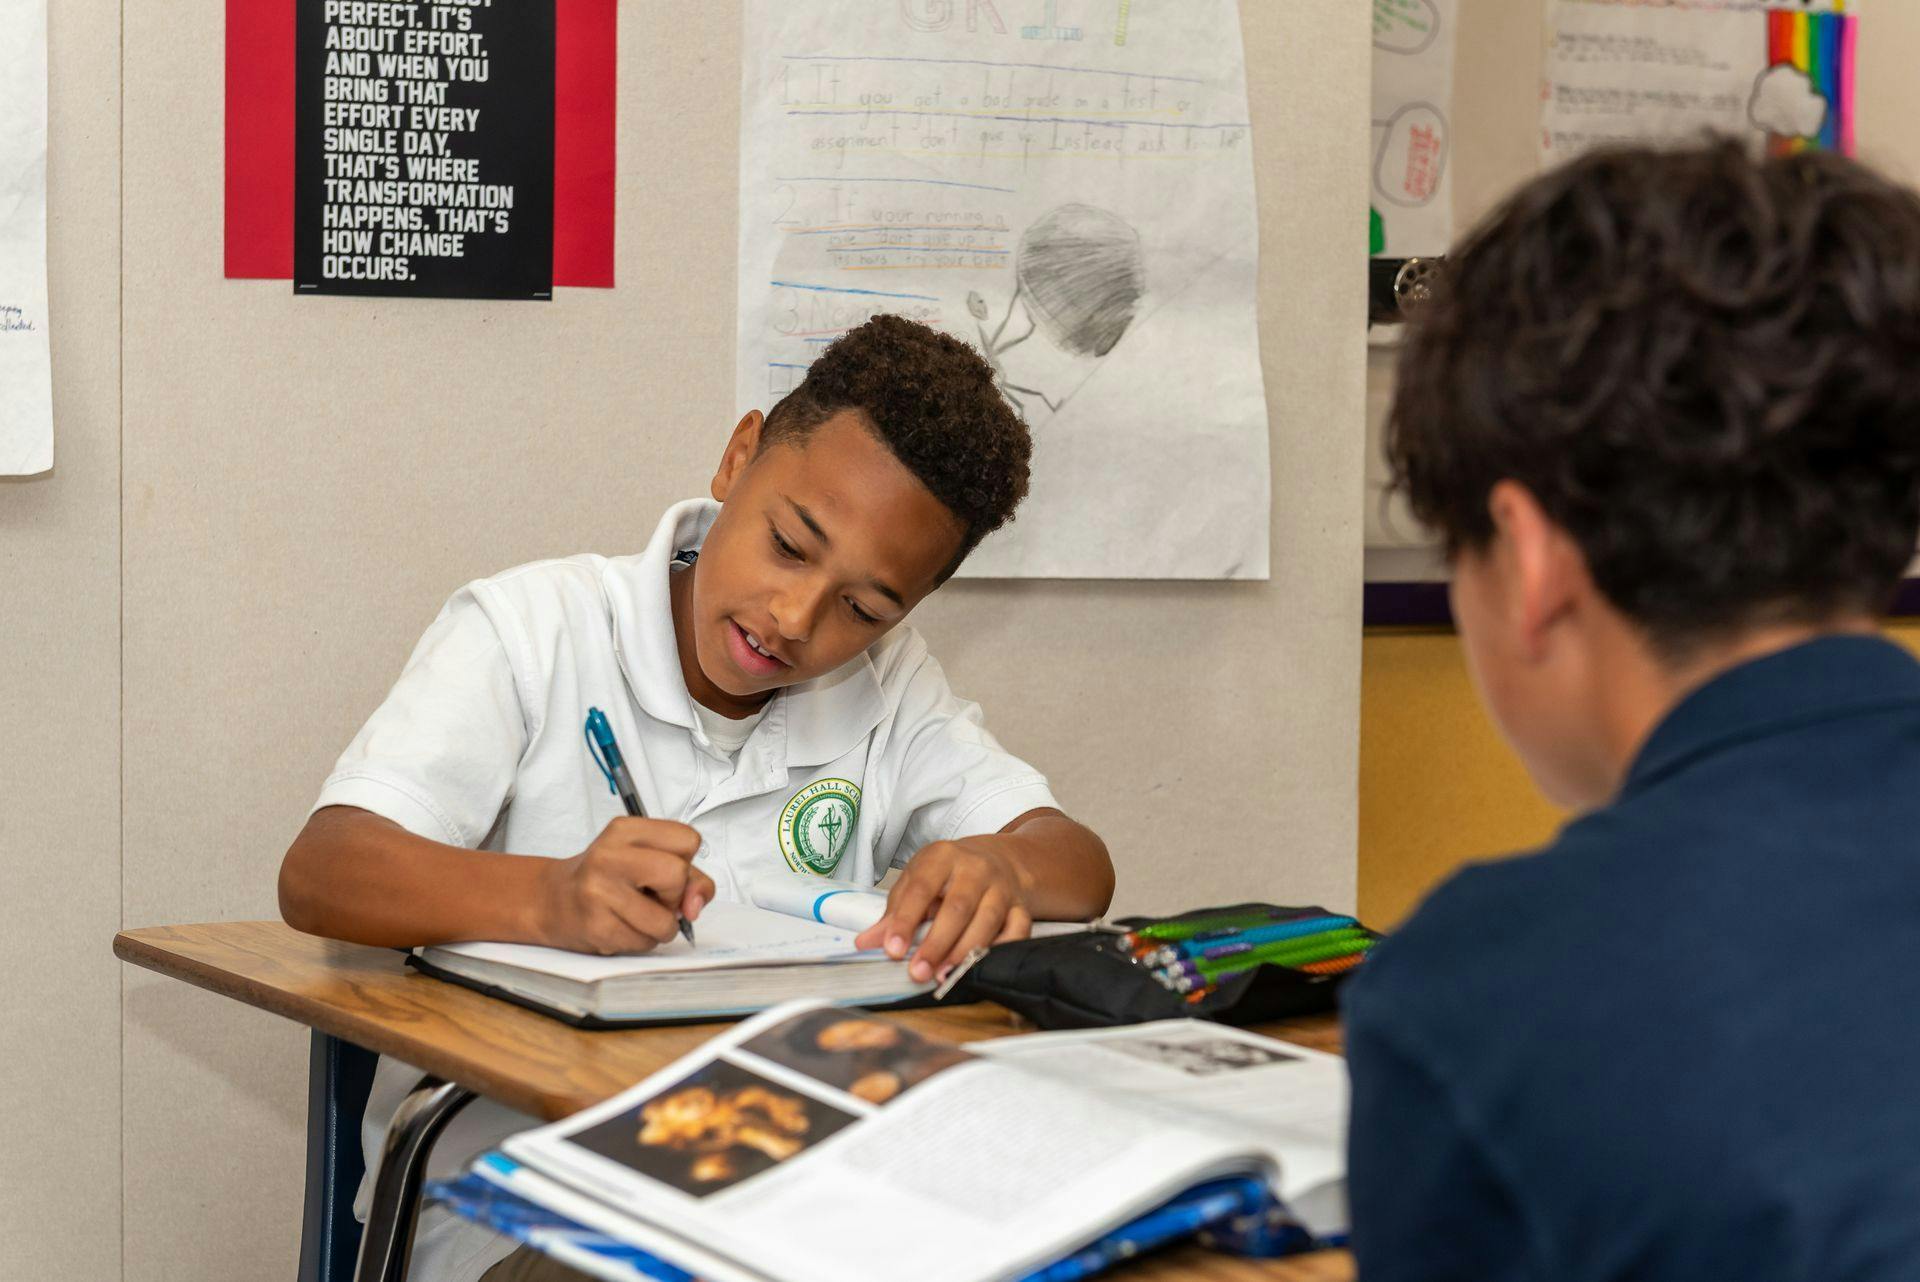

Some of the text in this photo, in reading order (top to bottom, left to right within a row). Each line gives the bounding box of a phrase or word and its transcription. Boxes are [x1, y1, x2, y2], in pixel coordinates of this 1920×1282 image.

[324, 0, 472, 31] PERFECT. IT'S
[324, 25, 488, 58] ABOUT EFFORT.
[324, 51, 489, 82] AND WHEN YOU
[324, 76, 449, 105] BRING THAT
[324, 102, 480, 132] EFFORT EVERY
[323, 127, 452, 158] SINGLE DAY,
[323, 153, 480, 183] THAT'S WHERE
[323, 178, 514, 209] TRANSFORMATION
[323, 203, 510, 234] HAPPENS. THAT'S
[322, 229, 465, 257] HOW CHANGE
[322, 255, 417, 281] OCCURS.
[783, 793, 809, 832] LAUREL
[810, 782, 842, 795] HALL
